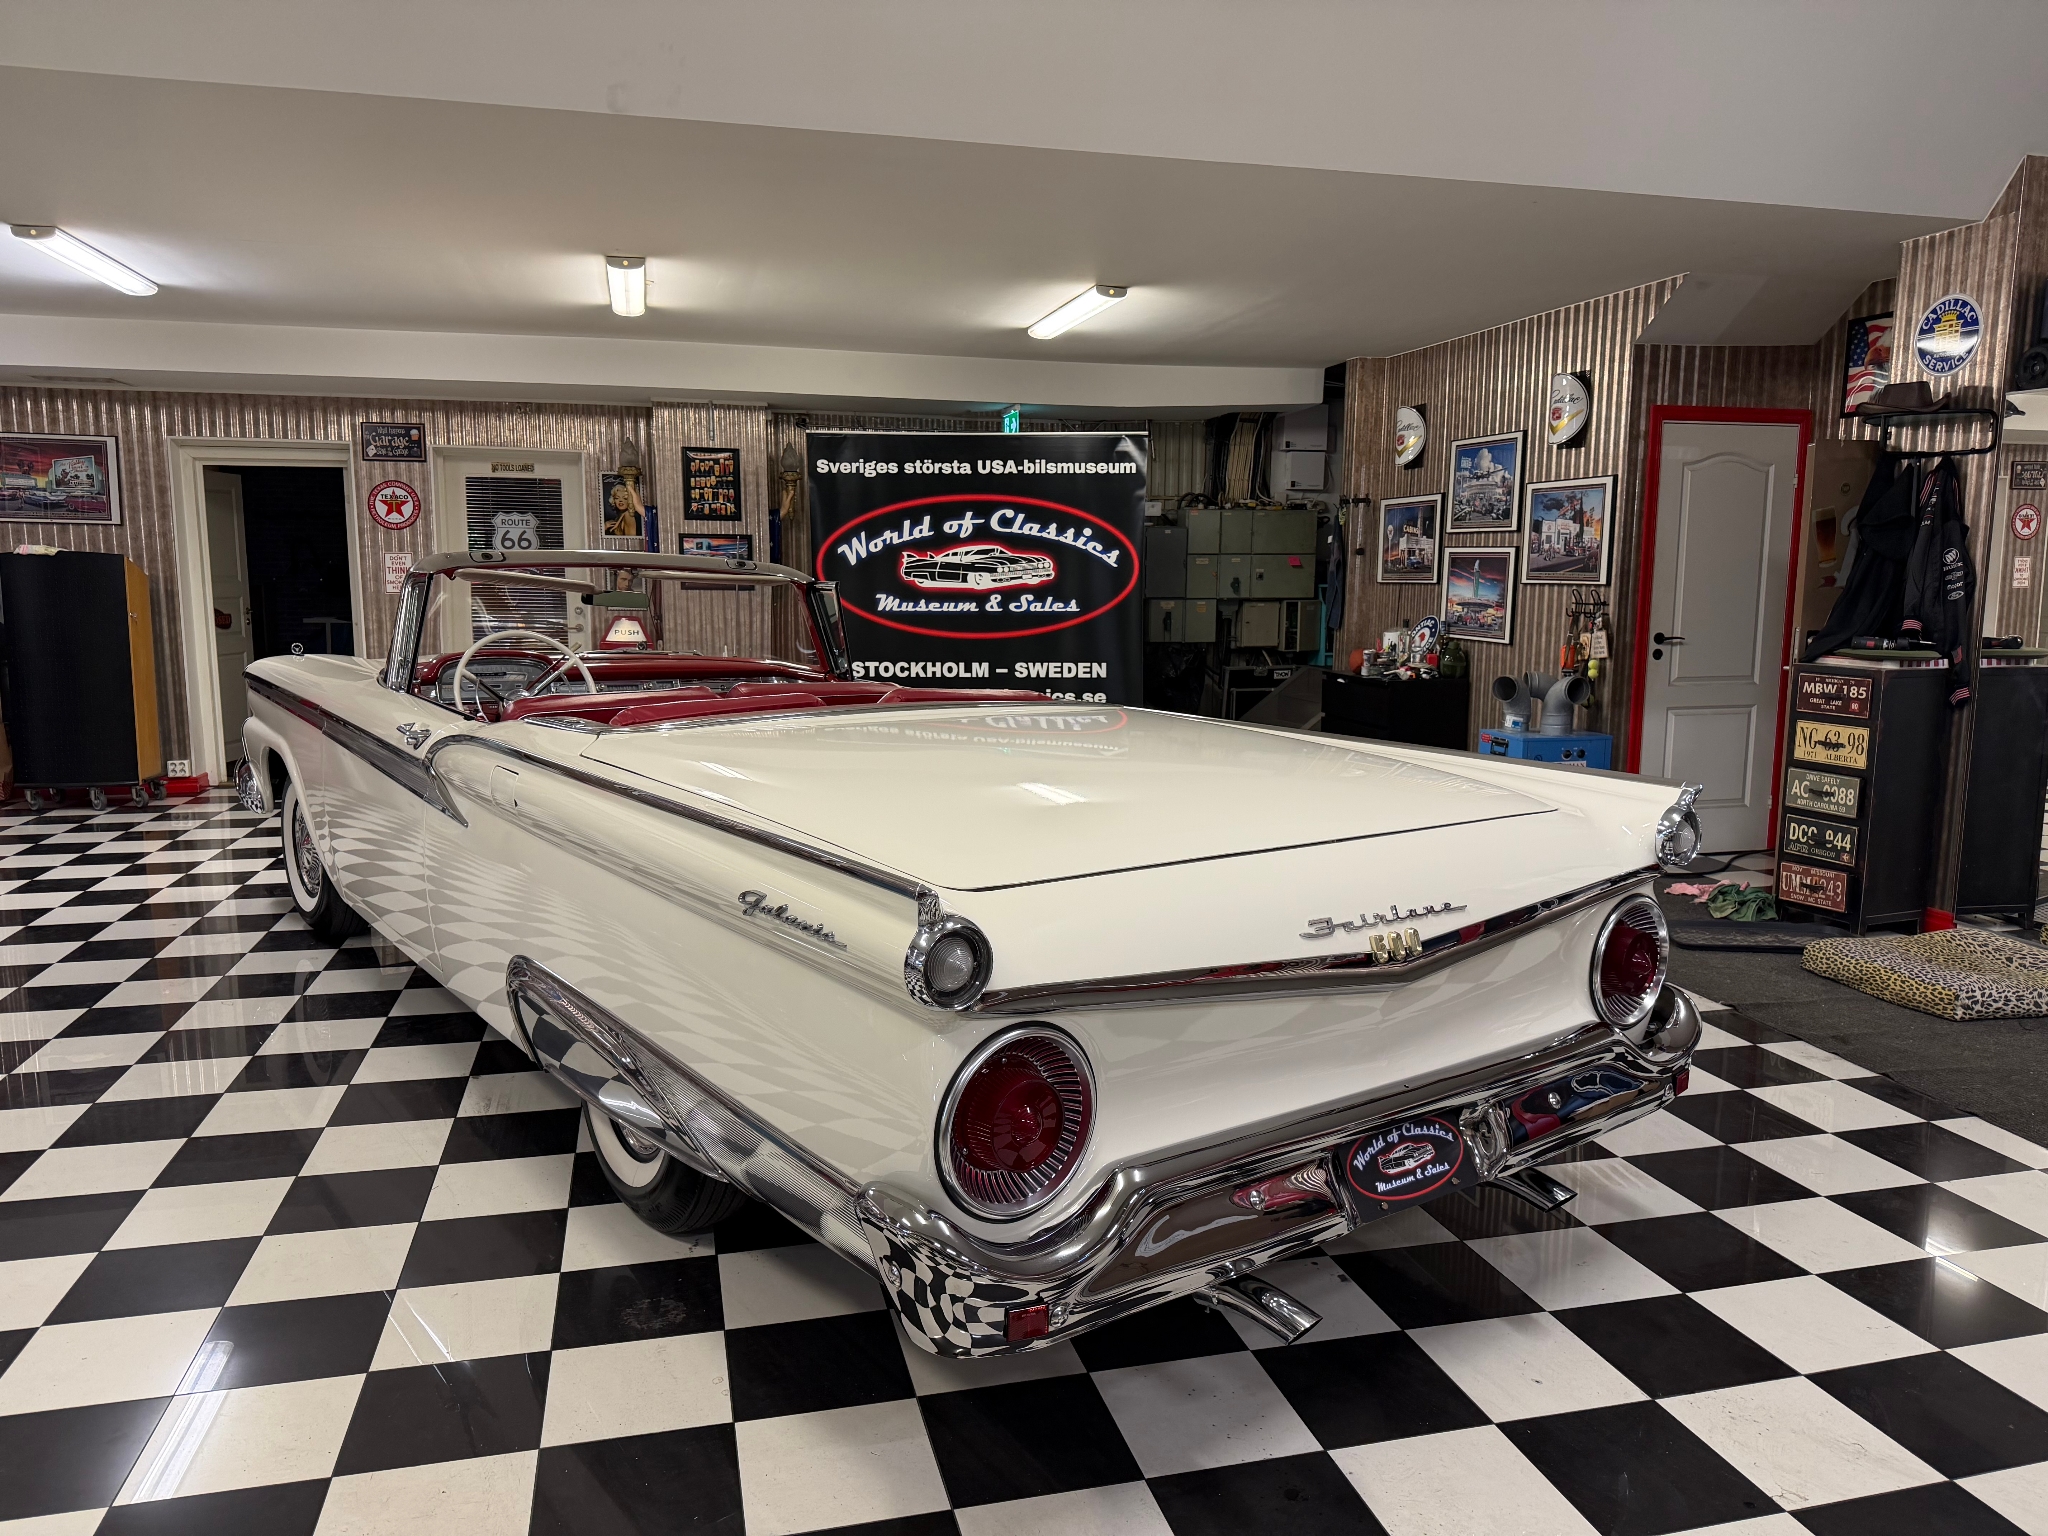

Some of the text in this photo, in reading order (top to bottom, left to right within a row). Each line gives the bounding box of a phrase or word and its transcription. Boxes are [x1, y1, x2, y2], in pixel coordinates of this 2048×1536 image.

[1922, 299, 1977, 330] CADILLAC
[1923, 351, 1969, 372] SERVICE
[500, 464, 515, 472] TOOLS
[815, 458, 1137, 477] Sveriges största USA-bilsmuseum
[387, 500, 402, 512] T
[501, 518, 531, 526] ROUTE
[500, 529, 532, 550] 66
[837, 509, 1120, 568] World of Classics
[875, 593, 1081, 612] Museum & Sales
[1411, 619, 1436, 637] ONTIAC
[851, 661, 990, 678] STOCKHOLM
[1014, 661, 1107, 678] SWEDEN
[1802, 681, 1867, 699] MBW 185
[1797, 726, 1819, 750] NG
[1847, 732, 1865, 756] 98
[1824, 753, 1858, 765] ALBERTA
[1790, 779, 1810, 798] AC
[1813, 801, 1838, 812] CAROLINA
[1299, 902, 1468, 940] Fairlane
[1368, 927, 1423, 965] 500
[1353, 1122, 1455, 1171] World of Classics
[1375, 1161, 1451, 1194] Museum & Sales
